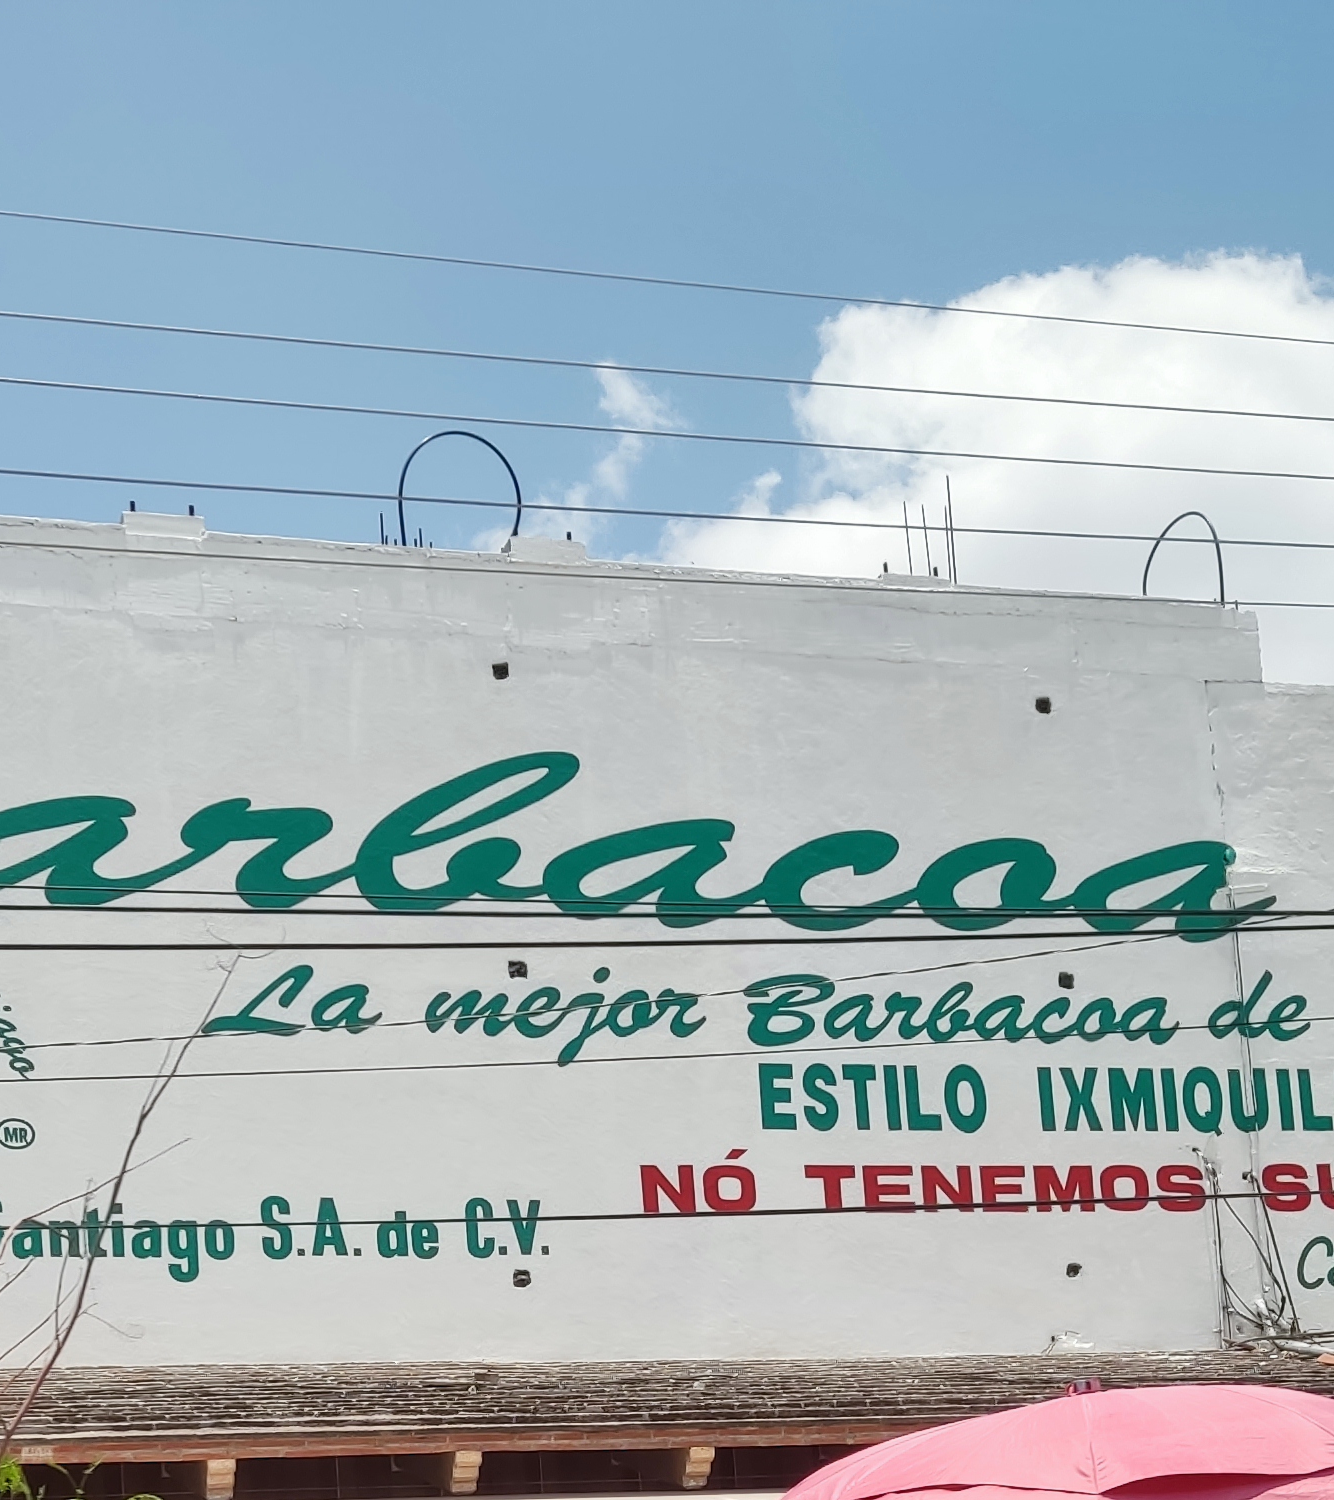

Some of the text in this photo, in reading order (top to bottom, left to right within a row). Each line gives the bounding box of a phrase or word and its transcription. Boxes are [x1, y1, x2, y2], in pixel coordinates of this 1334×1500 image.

[200, 964, 383, 1036] La
[424, 966, 707, 1067] mejor
[743, 973, 1181, 1046] Barbacoa
[1208, 971, 1311, 1042] de
[758, 1062, 988, 1134] ESTILO
[2, 1126, 28, 1145] MR
[640, 1148, 758, 1214] NÓ
[804, 1163, 1207, 1213] TENEMOS
[260, 1194, 363, 1260] S.A.
[377, 1211, 441, 1259] de
[464, 1197, 551, 1259] C.V.
